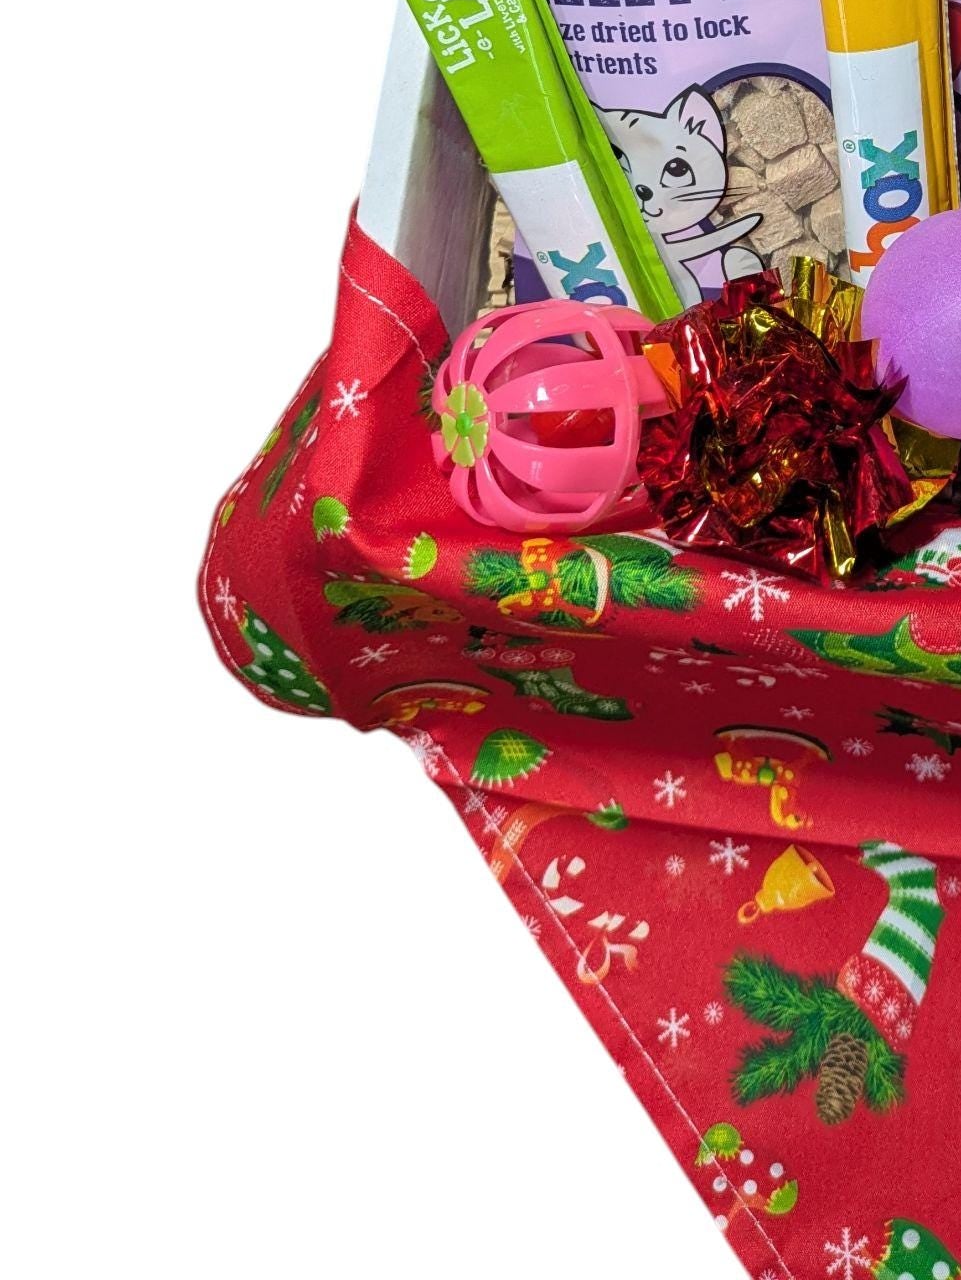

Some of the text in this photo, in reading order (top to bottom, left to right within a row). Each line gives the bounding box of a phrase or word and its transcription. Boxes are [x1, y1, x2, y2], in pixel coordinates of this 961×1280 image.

[560, 15, 751, 43] ze dried to lock
[509, 30, 526, 54] with
[570, 50, 658, 75] trients
